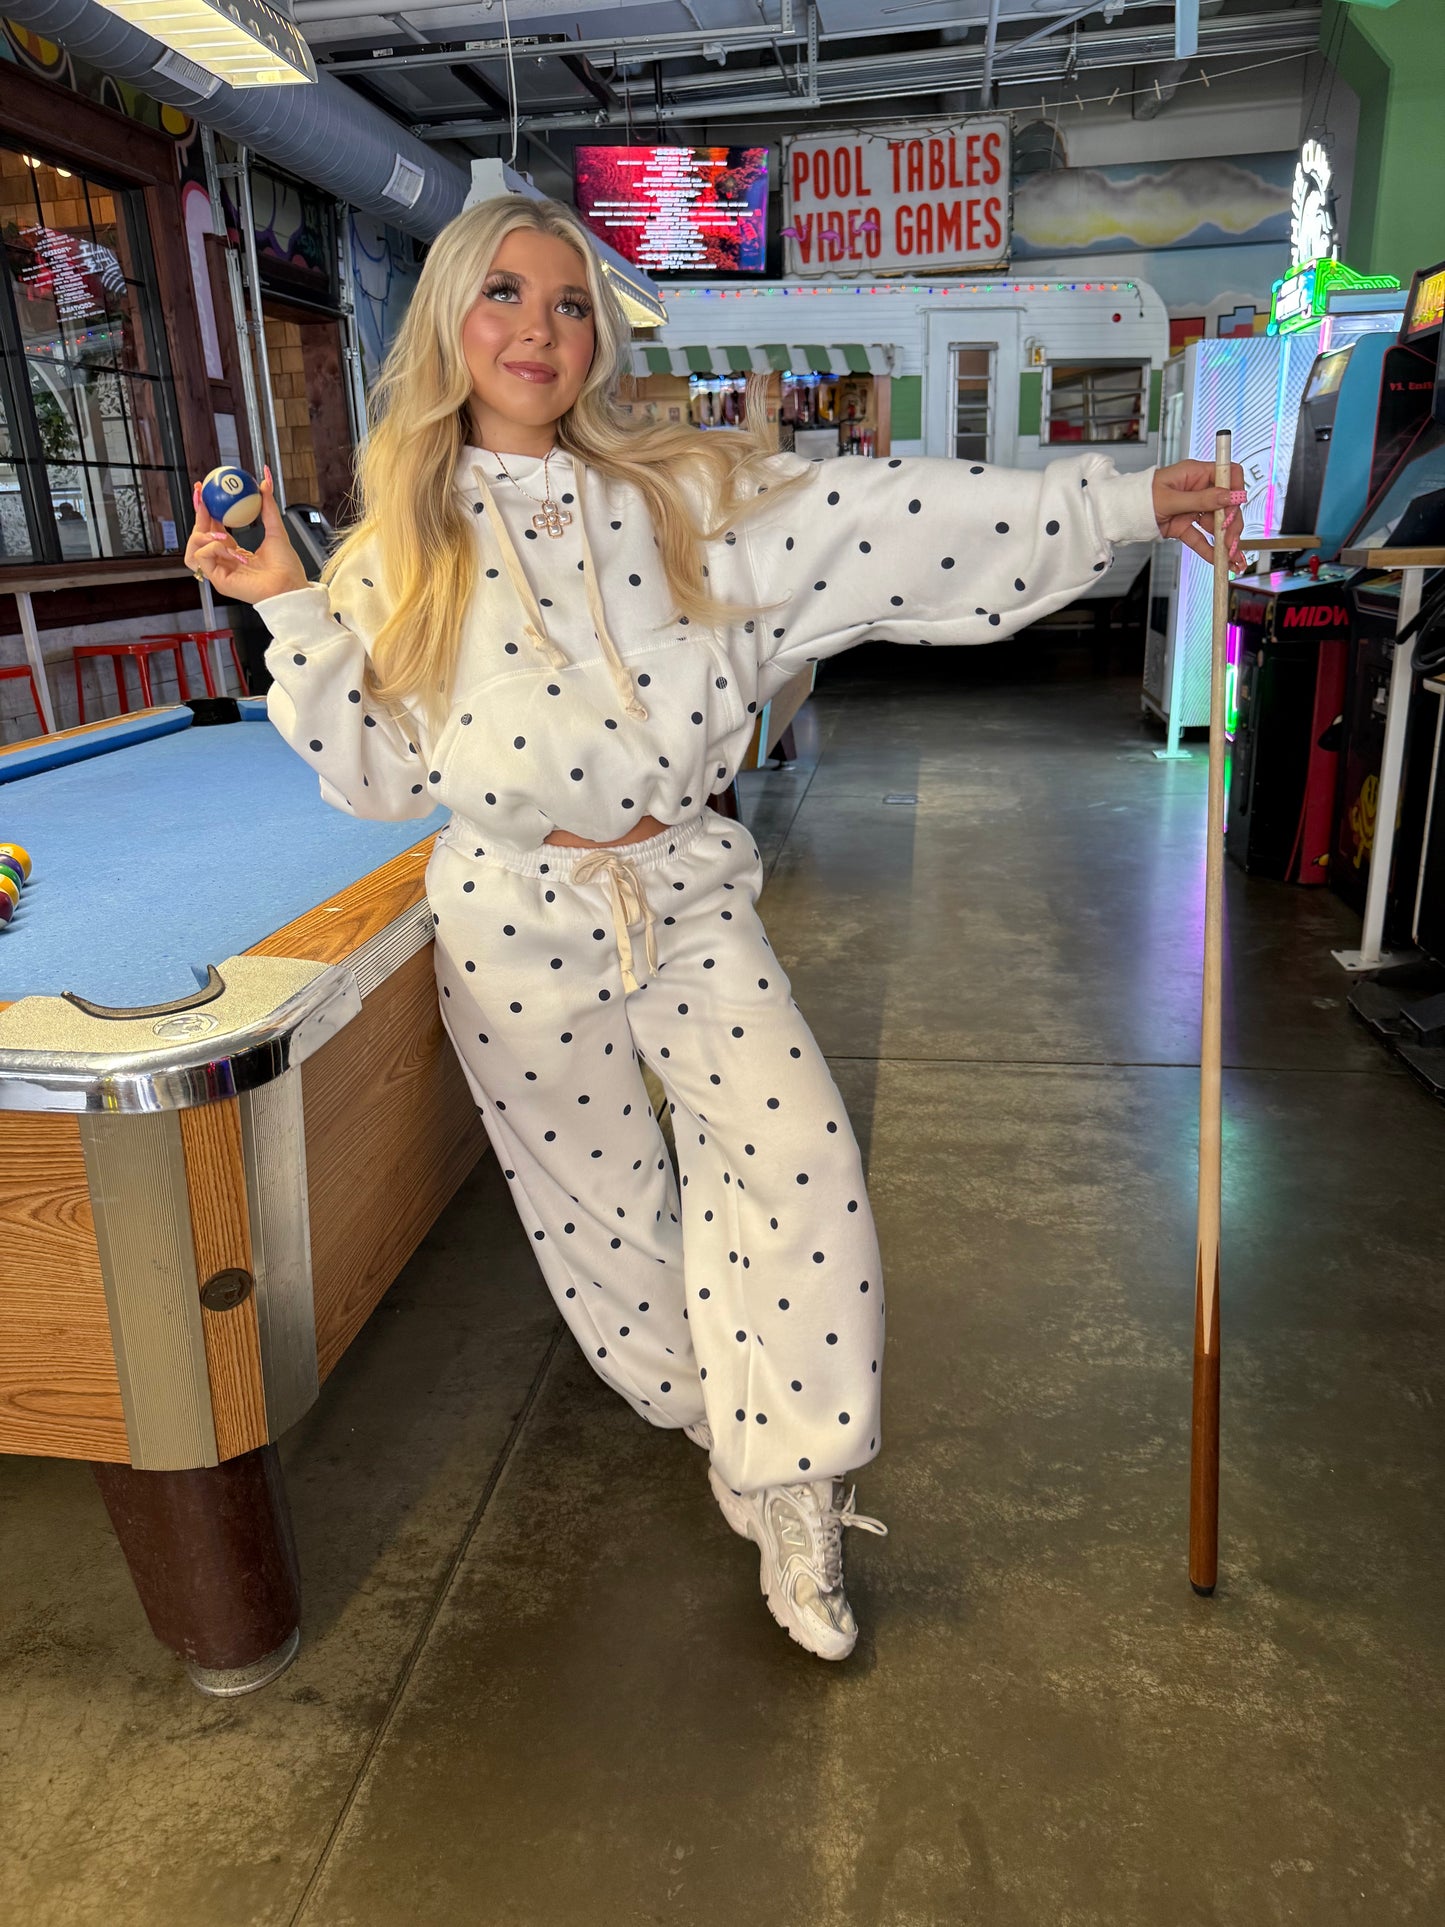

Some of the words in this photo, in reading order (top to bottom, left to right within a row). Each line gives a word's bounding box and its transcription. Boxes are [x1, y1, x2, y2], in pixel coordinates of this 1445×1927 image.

[793, 146, 871, 202] POOL
[887, 132, 1001, 194] TABLES
[794, 207, 882, 264] VIDEO
[895, 197, 1001, 256] GAMES
[225, 478, 239, 491] 10
